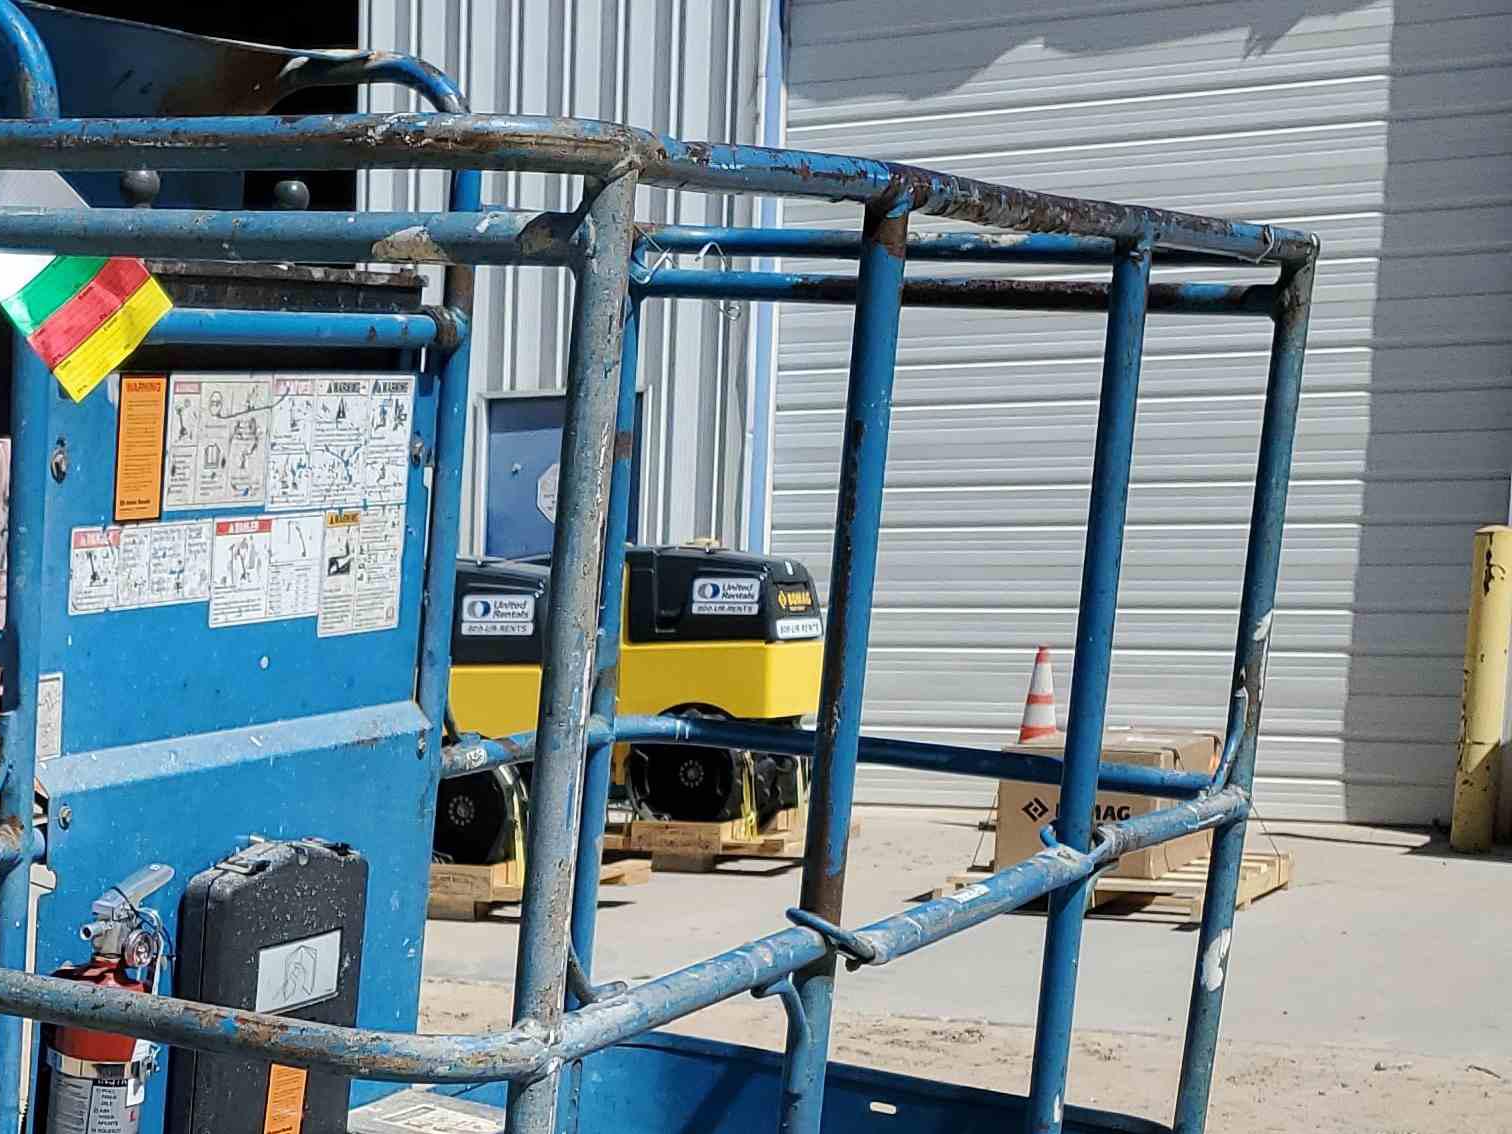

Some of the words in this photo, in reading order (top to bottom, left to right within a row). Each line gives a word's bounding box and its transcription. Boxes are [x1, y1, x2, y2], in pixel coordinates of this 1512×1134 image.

[126, 381, 161, 393] WARNING
[722, 583, 753, 592] United
[721, 591, 755, 600] Rentals
[493, 600, 526, 610] United
[492, 609, 529, 619] Rentals
